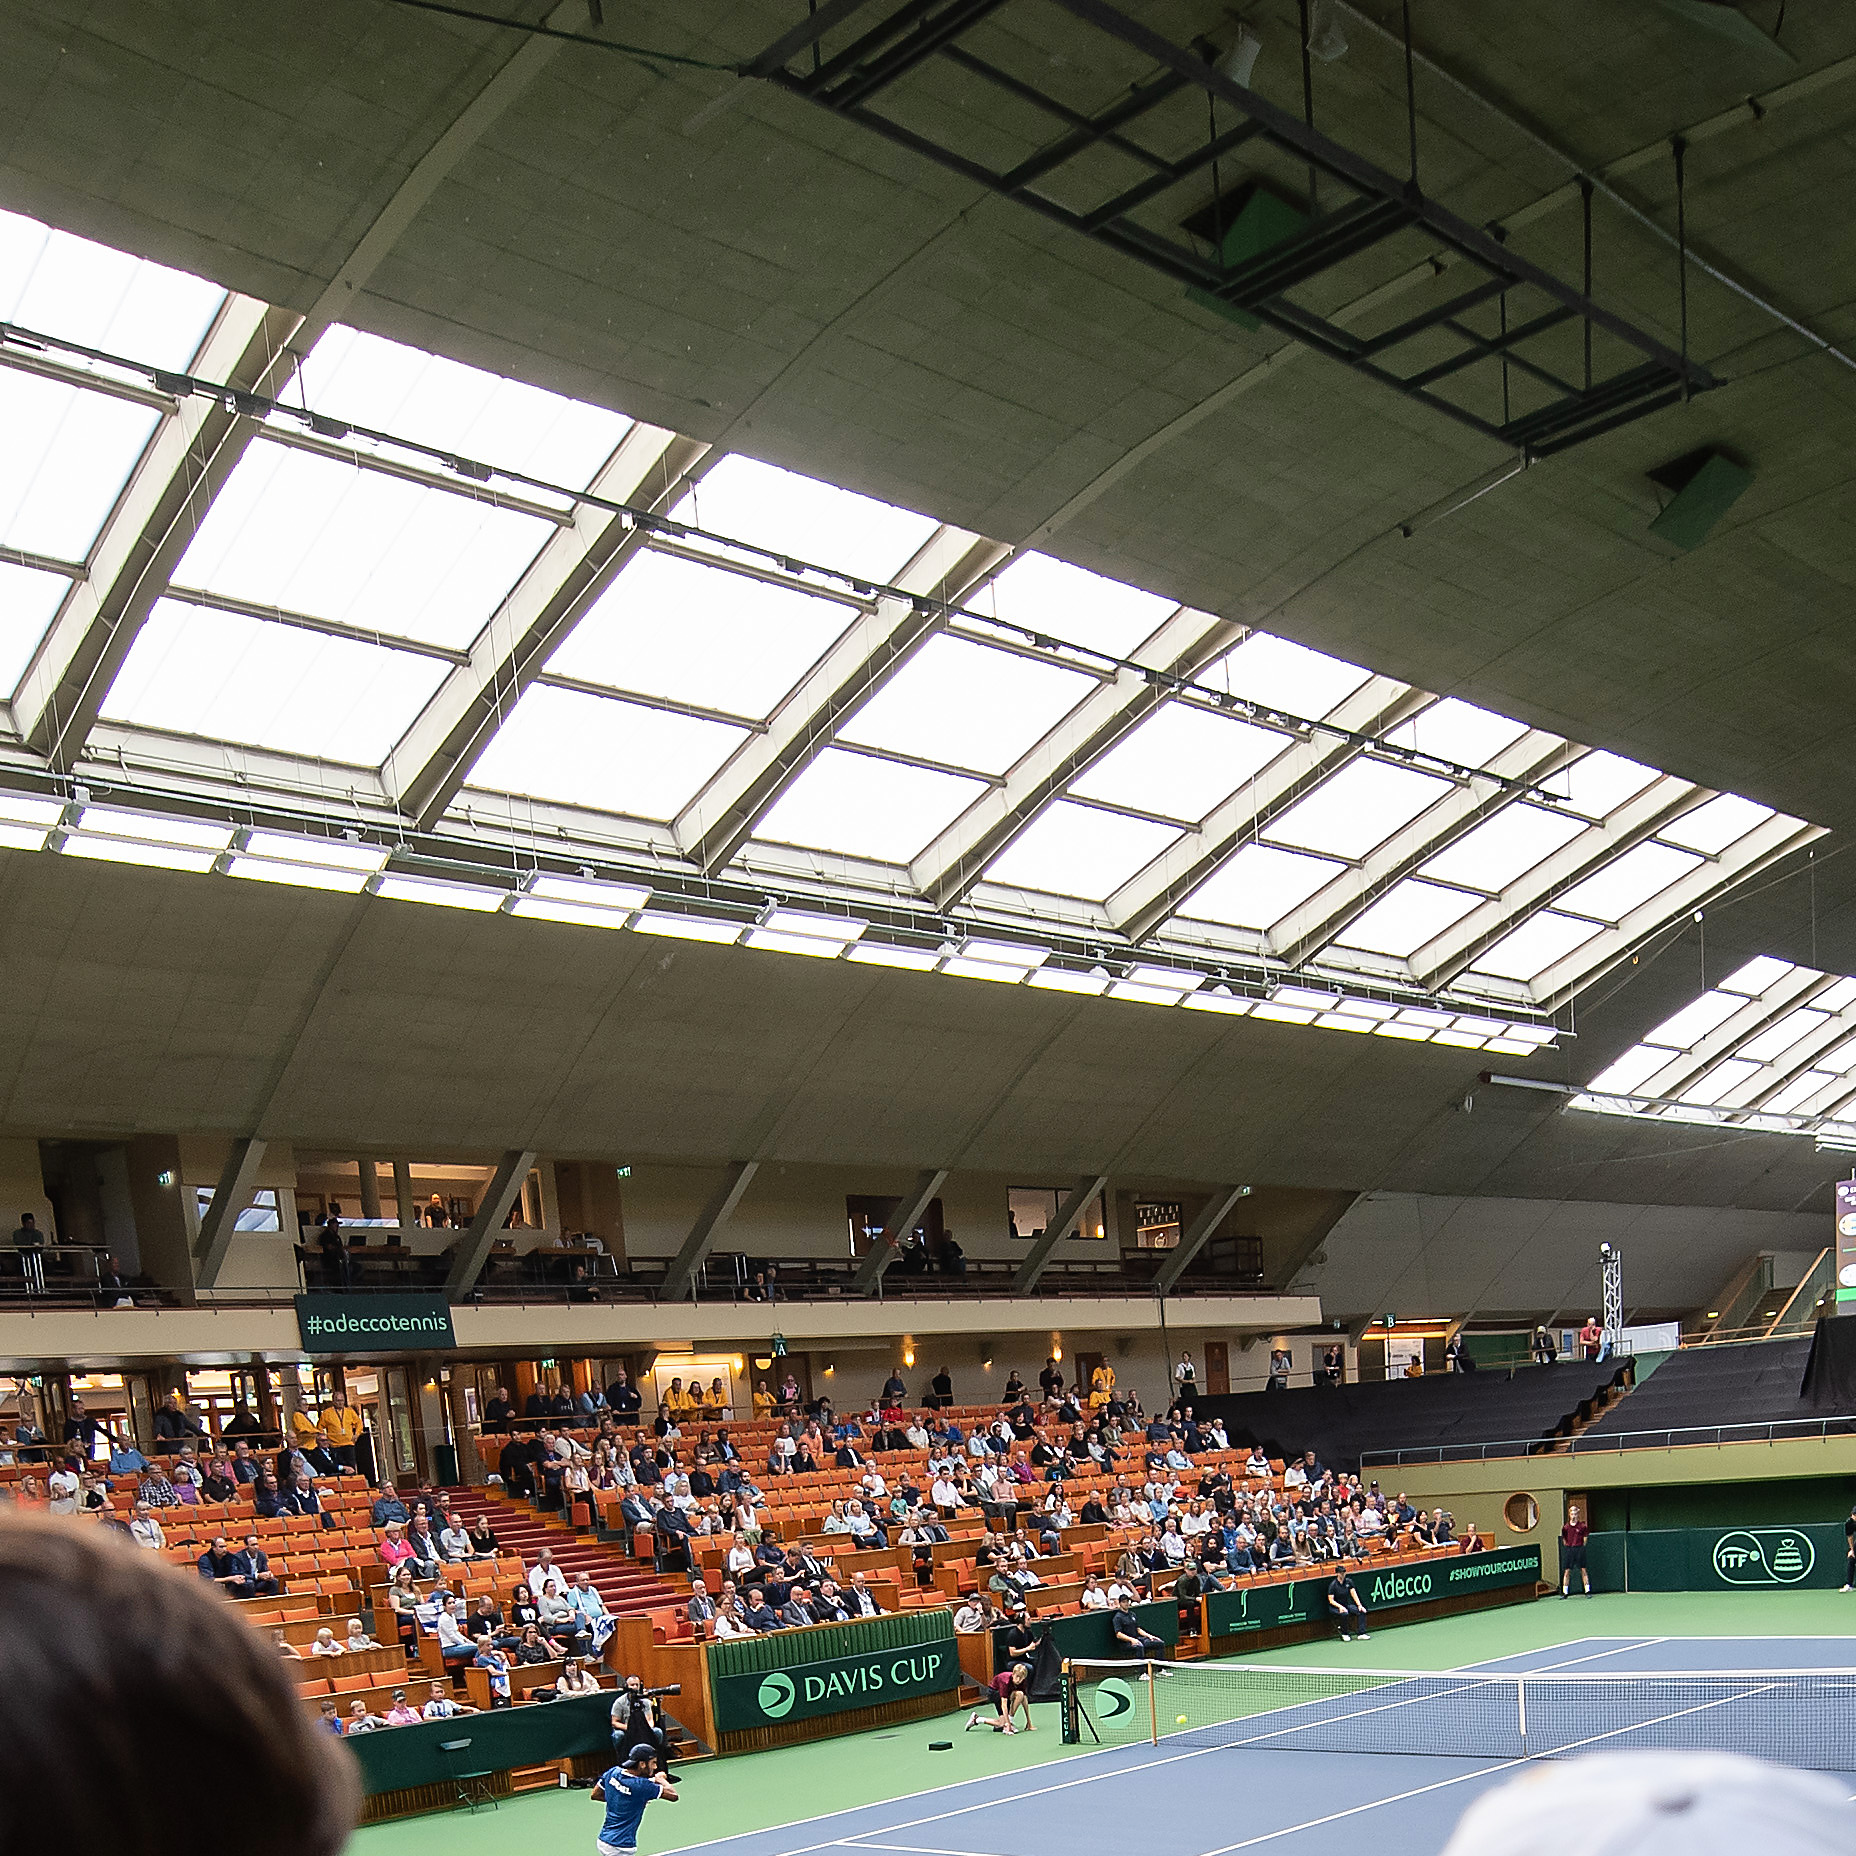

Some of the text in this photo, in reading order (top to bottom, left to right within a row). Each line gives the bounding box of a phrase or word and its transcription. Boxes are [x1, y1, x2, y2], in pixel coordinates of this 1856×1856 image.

[307, 1311, 448, 1335] #adeccotennis
[778, 1343, 787, 1356] A
[1721, 1554, 1748, 1568] ITF
[1371, 1556, 1539, 1602] Adecco #SHOWYOURCOLOURS
[804, 1654, 941, 1702] DAVIS CUP
